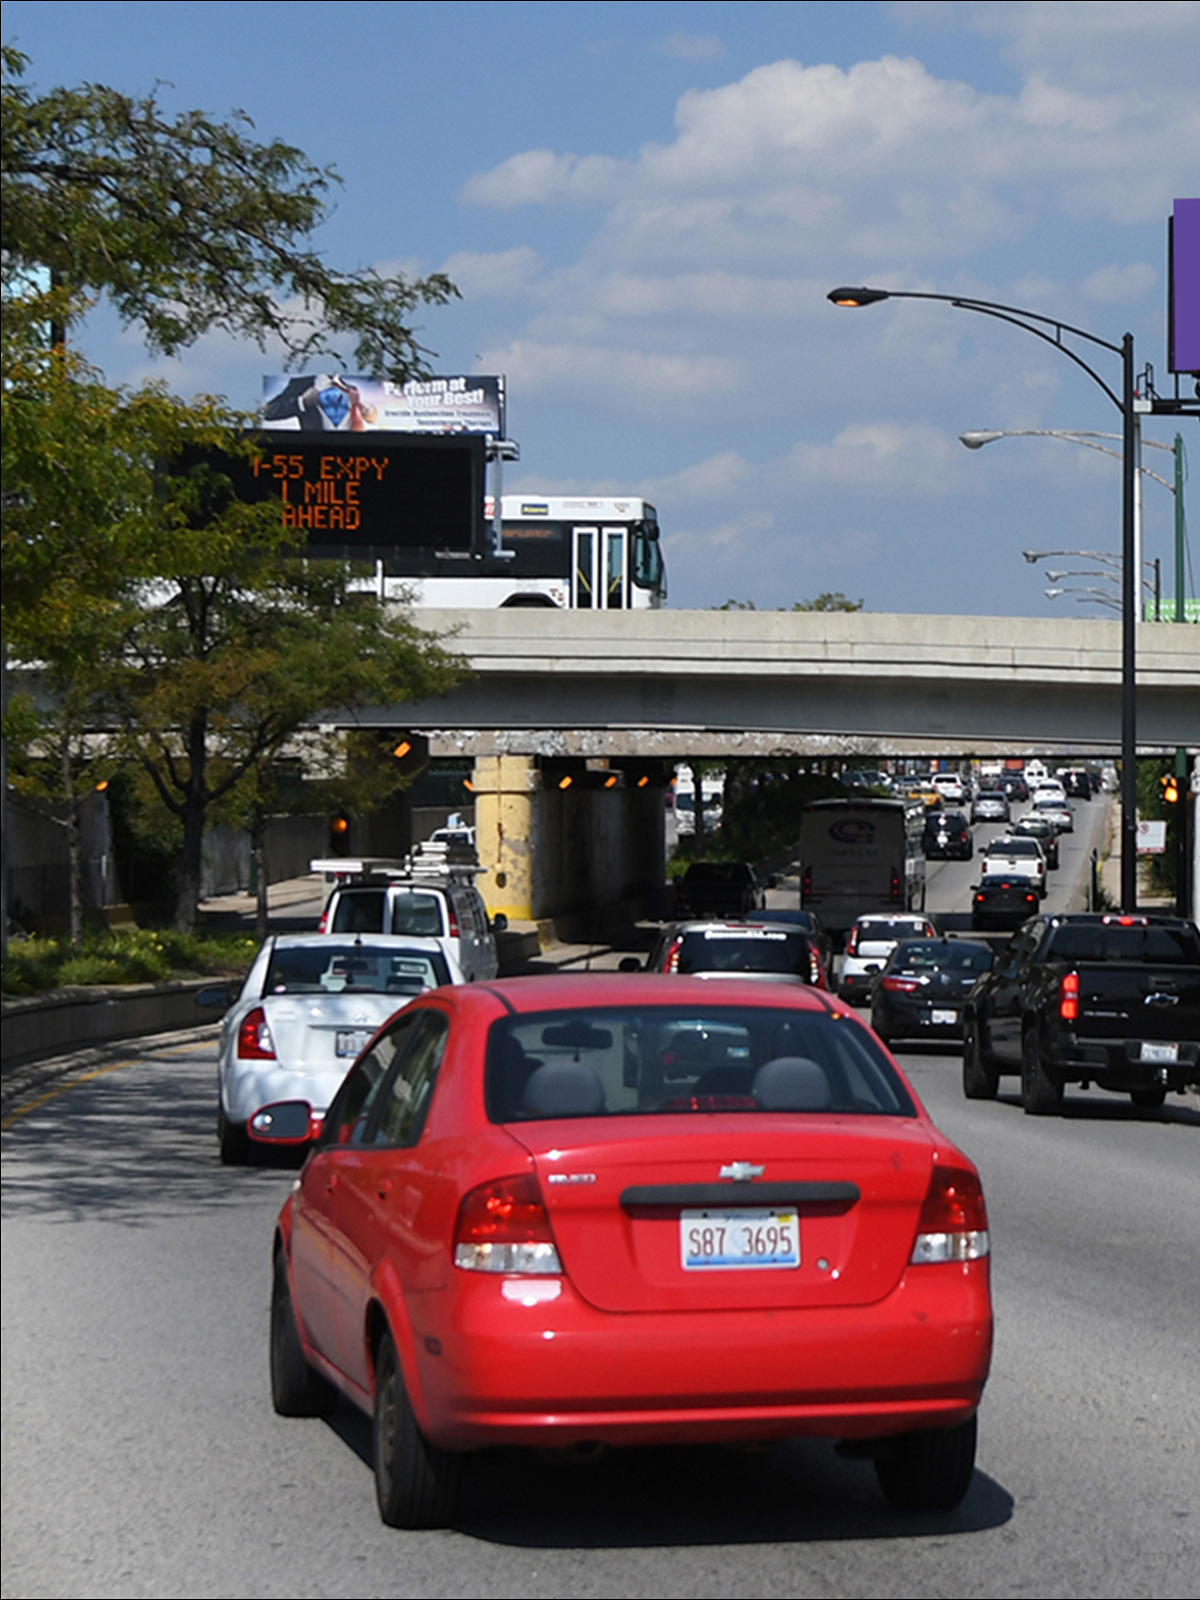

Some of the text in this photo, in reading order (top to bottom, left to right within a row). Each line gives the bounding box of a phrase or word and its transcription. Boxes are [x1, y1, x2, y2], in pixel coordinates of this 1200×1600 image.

[449, 376, 466, 391] at
[407, 388, 484, 408] Your Best!
[253, 455, 389, 481] I-55 EXPY
[304, 480, 360, 505] MILE
[281, 504, 361, 530] AHEAD
[689, 1226, 793, 1257] S87 3695
